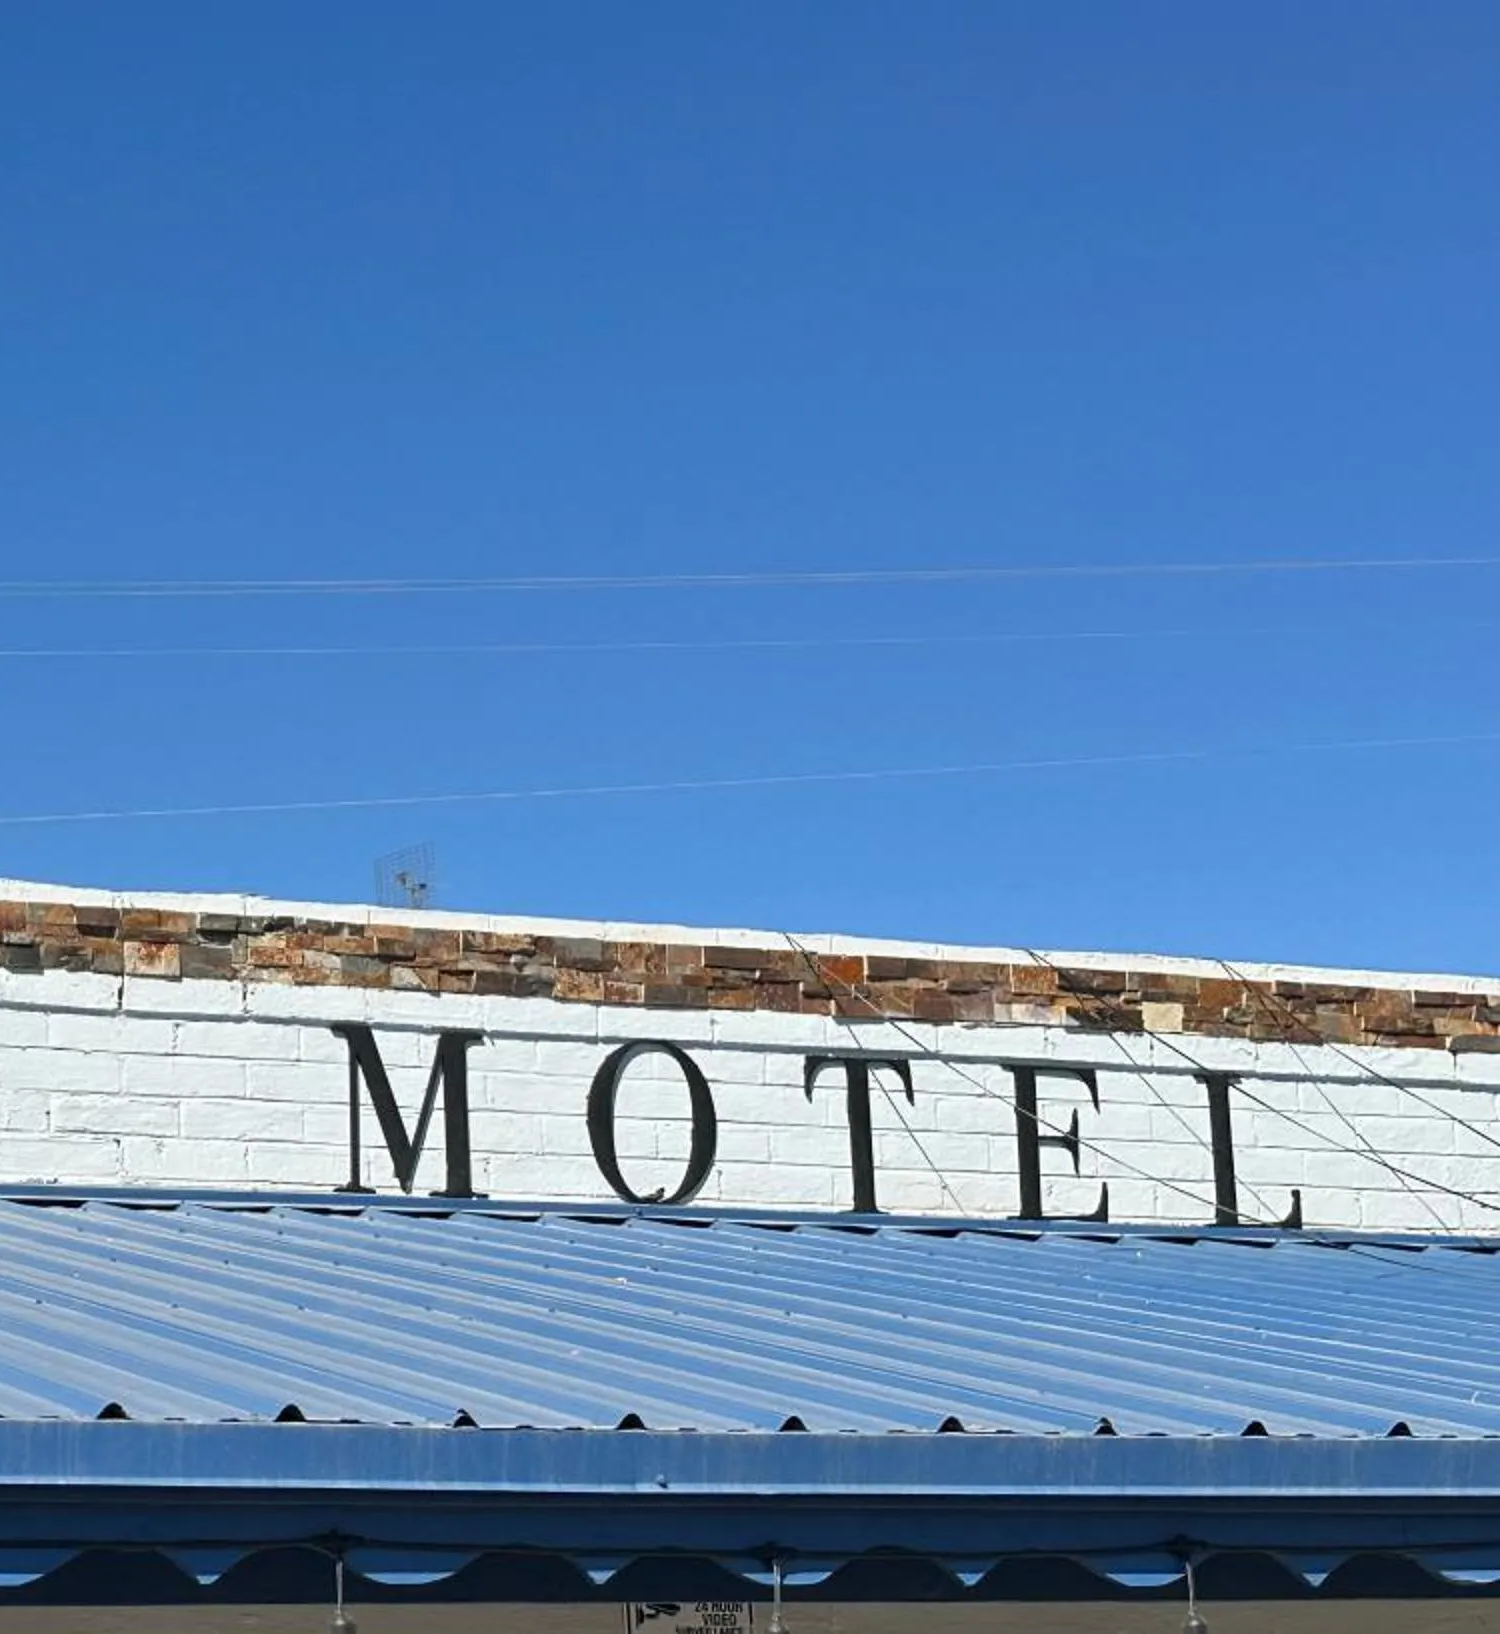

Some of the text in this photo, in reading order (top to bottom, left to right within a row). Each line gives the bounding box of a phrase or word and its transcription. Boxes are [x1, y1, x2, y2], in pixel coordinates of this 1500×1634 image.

[331, 1021, 1303, 1230] MOTEL
[712, 1602, 743, 1612] HOUR
[702, 1613, 737, 1626] VIDEO
